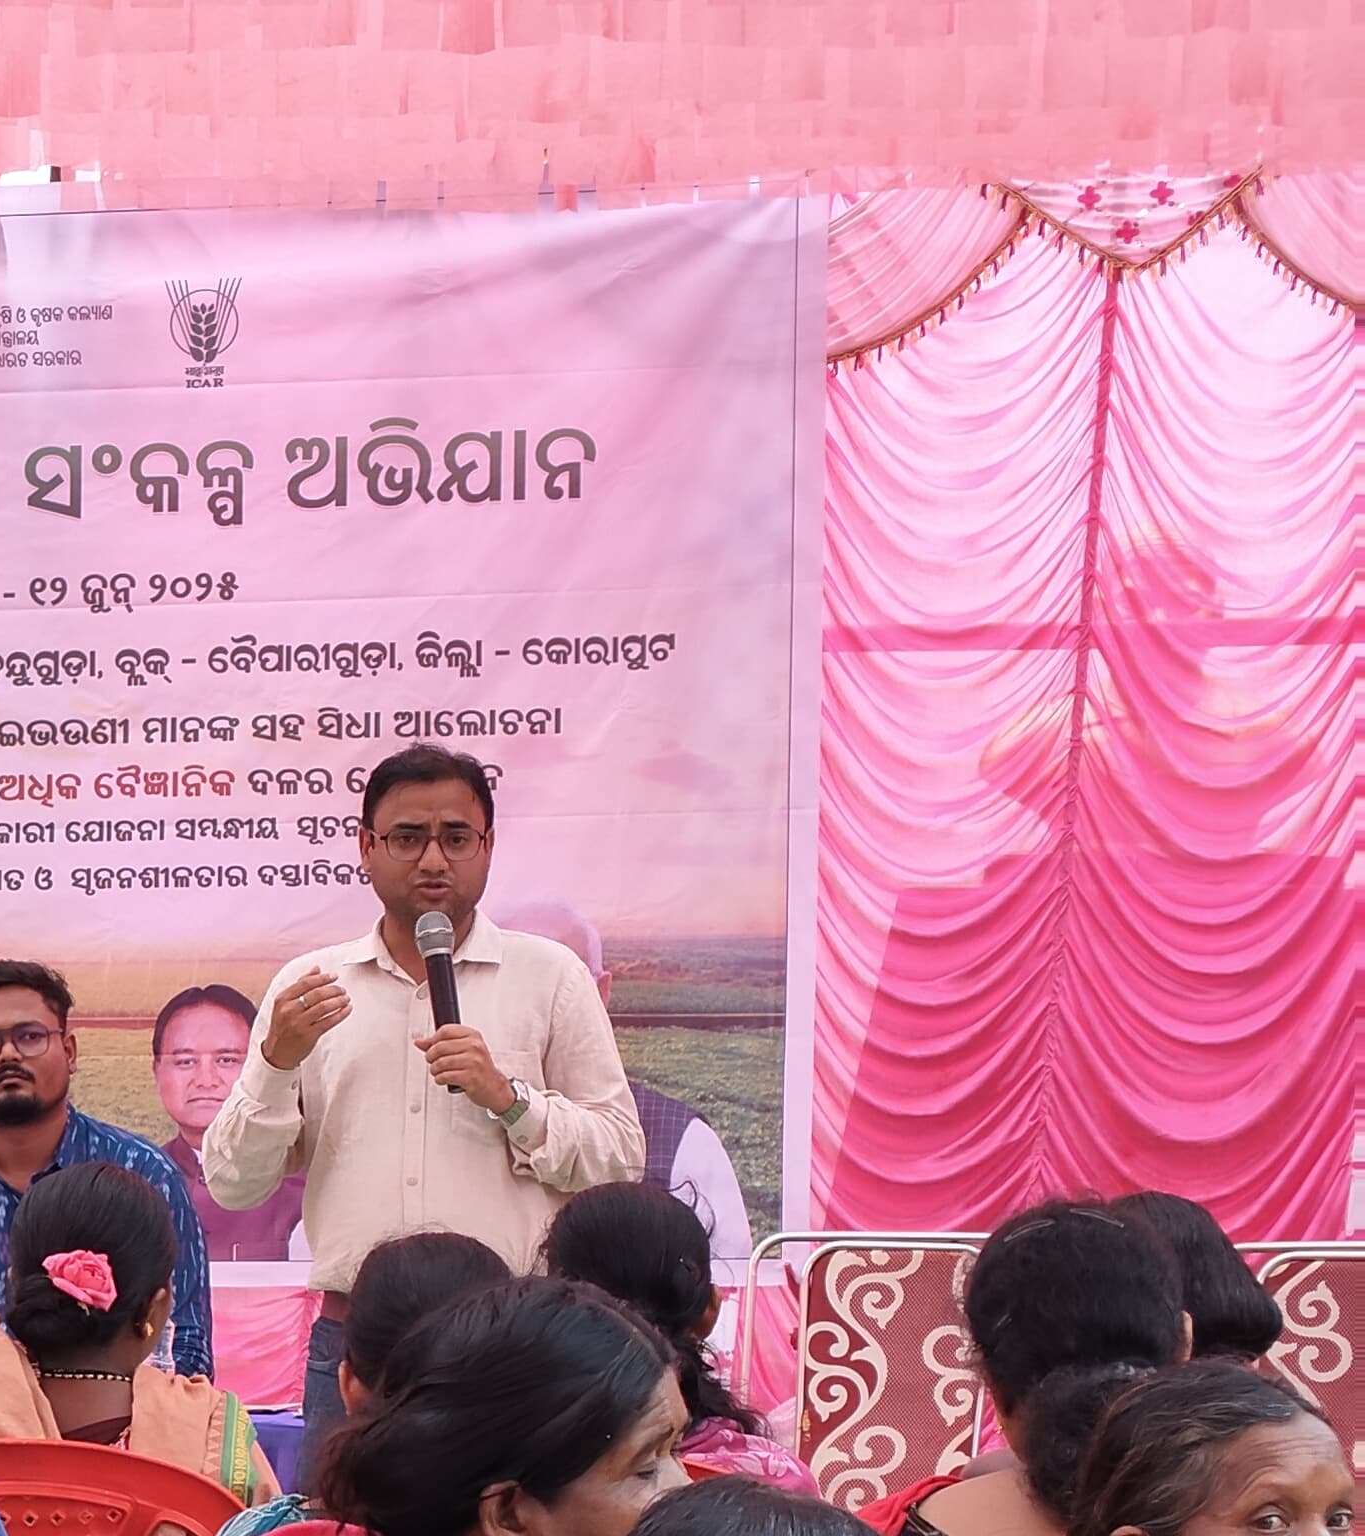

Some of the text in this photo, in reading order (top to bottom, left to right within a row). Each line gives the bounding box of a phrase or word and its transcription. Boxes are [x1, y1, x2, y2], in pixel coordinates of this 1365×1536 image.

[15, 307, 26, 323] ଓ
[31, 349, 82, 366] ସରକାର
[185, 377, 223, 388] ICAR
[25, 440, 253, 526] ସଂକଳ୍ପ
[285, 417, 596, 508] ଅଭିଯାନ
[29, 576, 67, 606] ୧୨
[81, 572, 136, 613] ଜୁନ୍
[149, 571, 239, 603] ୨୦୨୫
[115, 647, 172, 686] ବ୍ଲକ୍
[522, 633, 675, 670] କୋରାପୁଟ
[142, 715, 239, 743] ମାନଙ୍କ
[252, 713, 305, 741] ସହ
[317, 706, 380, 740] ସିଧା
[394, 707, 561, 738] ଆଲୋଚନା
[248, 767, 333, 795] ଦଳର
[65, 818, 165, 842] ଯୋଜନା
[297, 815, 361, 845] ସୂଚନ
[35, 866, 53, 890] ଓ
[71, 865, 248, 896] ସୃଜନଶୀଳତାର
